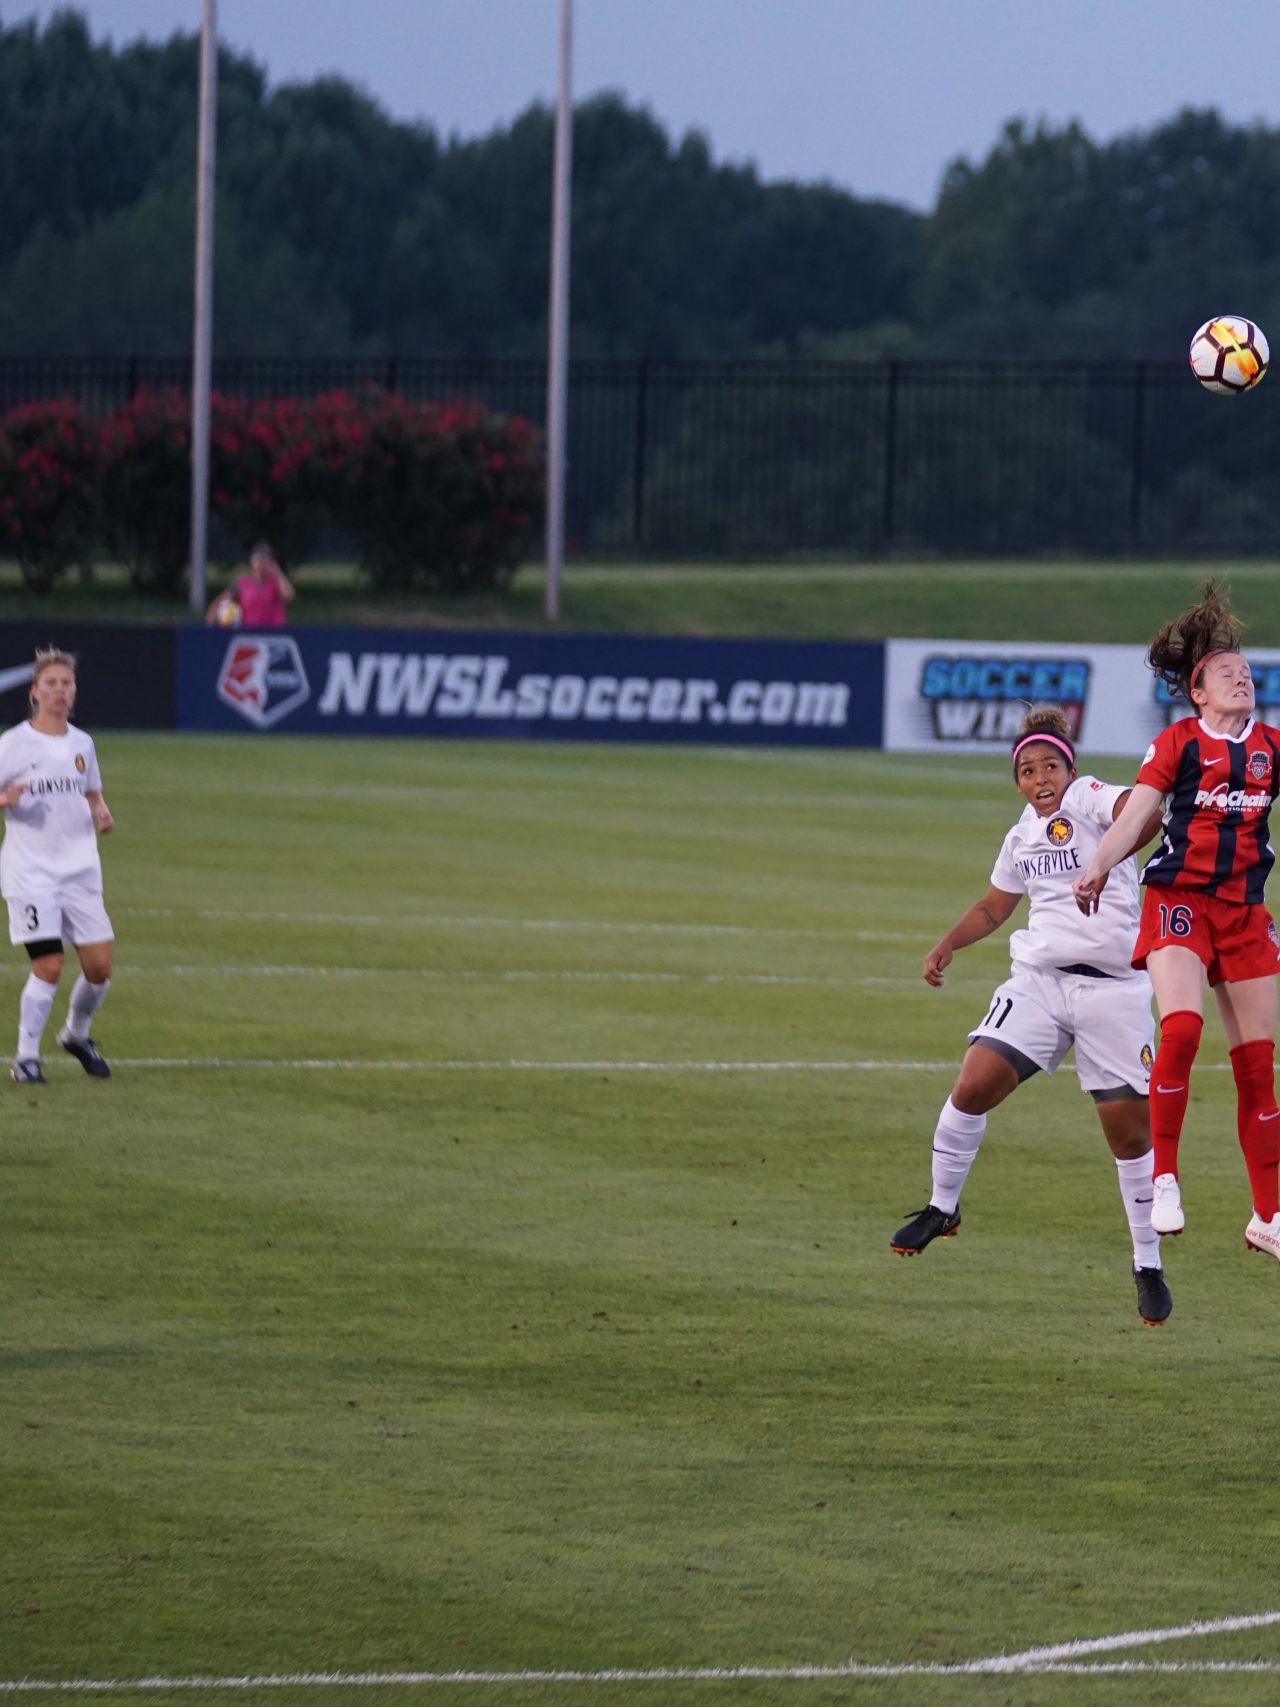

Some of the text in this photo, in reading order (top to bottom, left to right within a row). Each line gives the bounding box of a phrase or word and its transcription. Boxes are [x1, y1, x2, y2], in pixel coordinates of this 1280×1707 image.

[320, 652, 849, 725] NWSLsoccer.com
[921, 658, 1091, 699] SOCCER
[25, 904, 39, 931] 3
[1159, 904, 1193, 939] 16
[984, 996, 1013, 1028] 11
